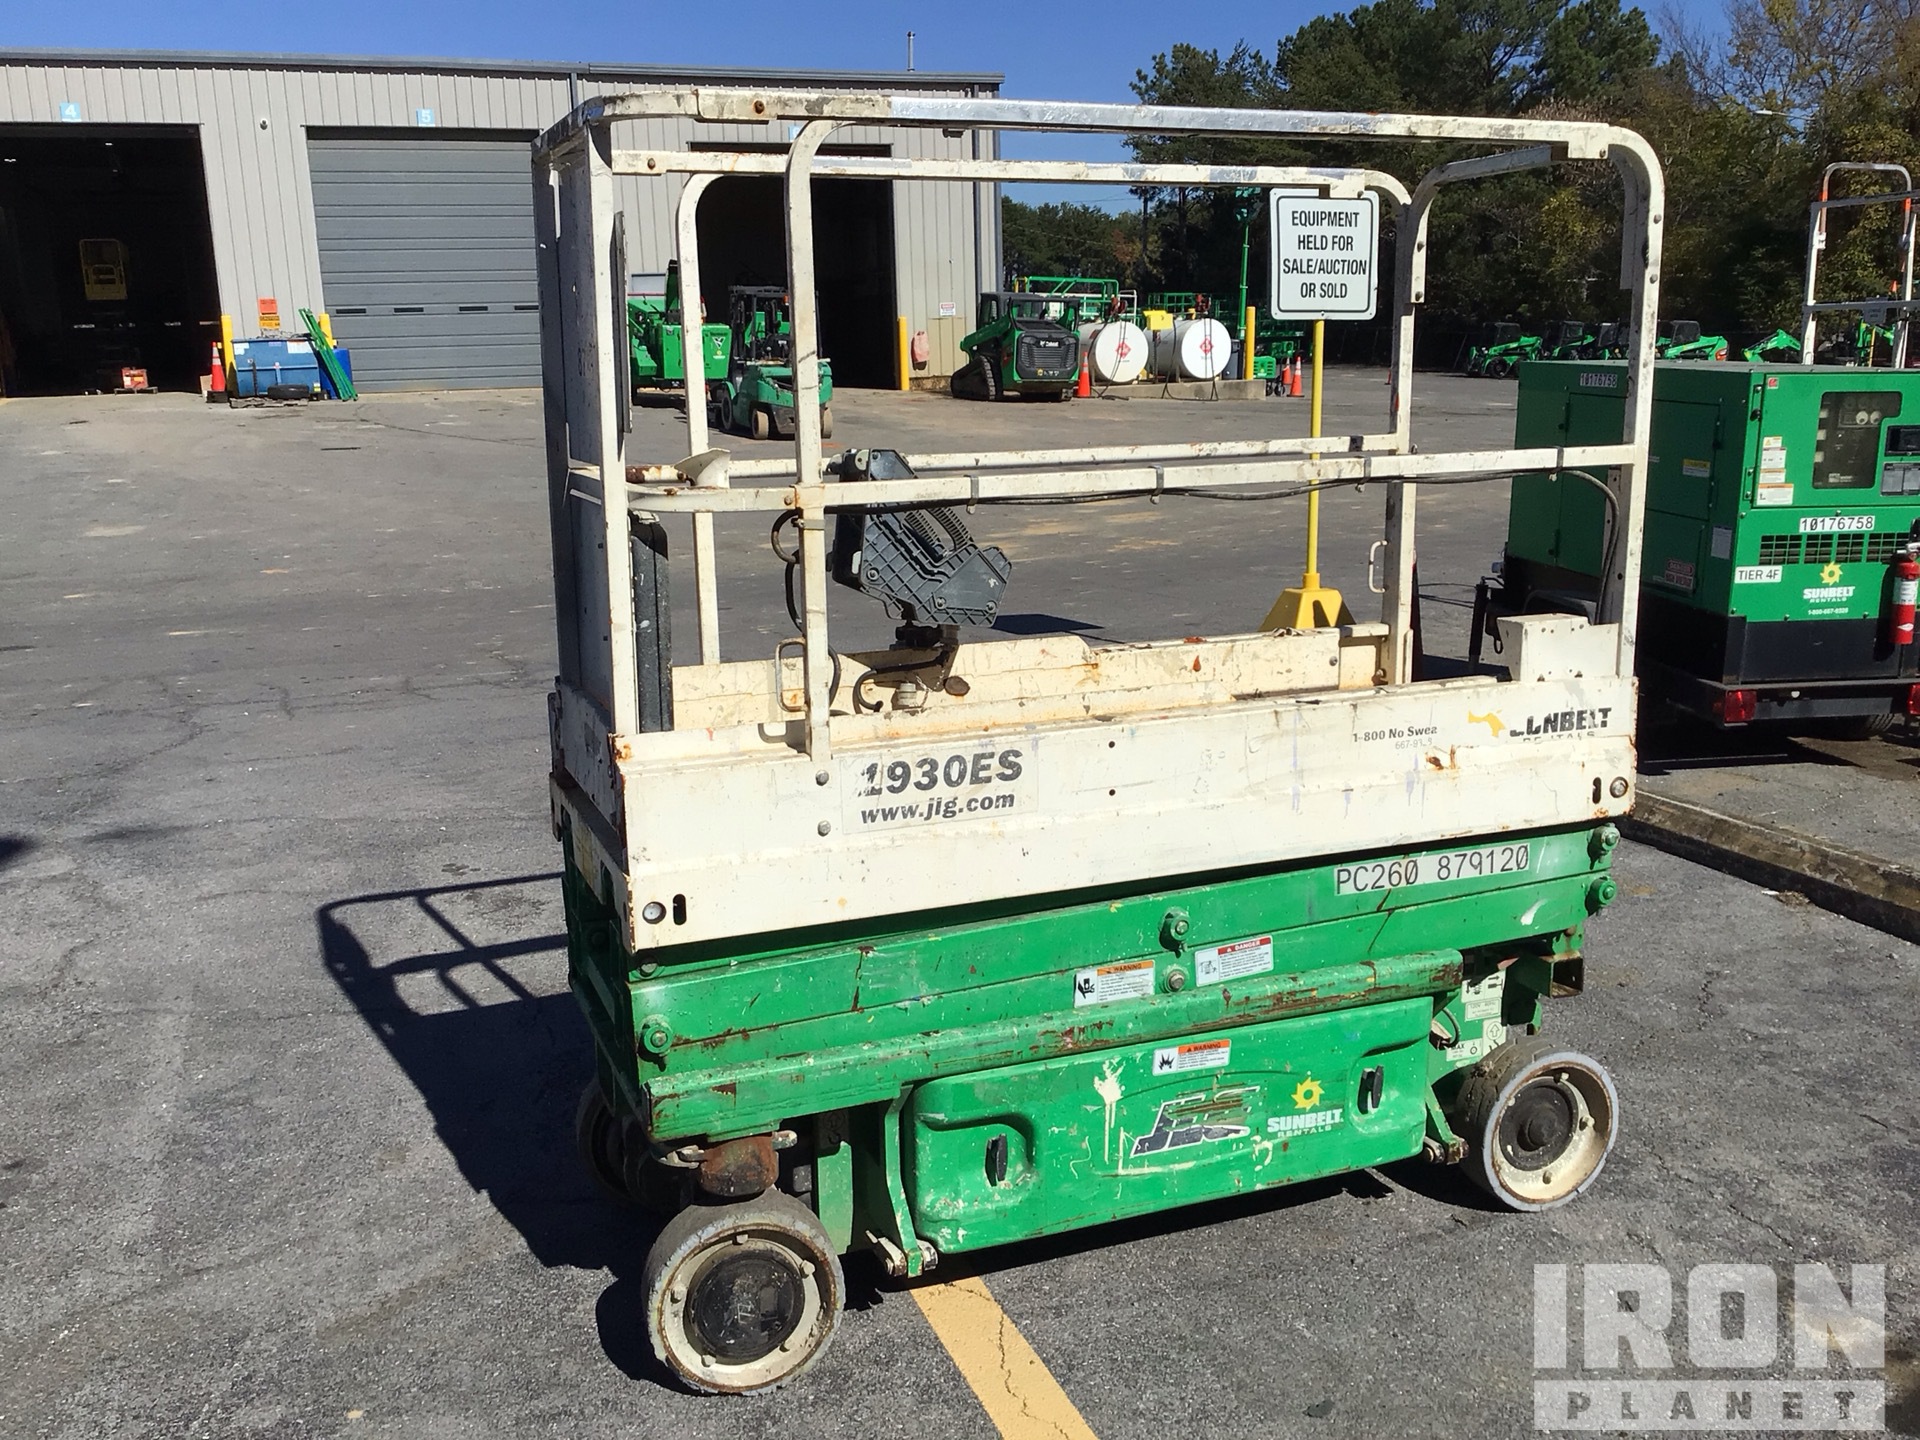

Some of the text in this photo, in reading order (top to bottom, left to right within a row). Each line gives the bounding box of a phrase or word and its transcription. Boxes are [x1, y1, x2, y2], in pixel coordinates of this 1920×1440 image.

[64, 103, 77, 118] 4
[421, 109, 431, 123] 5
[1291, 210, 1360, 228] EQUIPMENT
[1297, 234, 1354, 251] HELD FOR
[1282, 258, 1367, 275] SALE/AUCTION
[1300, 282, 1348, 298] OR SOLD
[1801, 516, 1874, 531] 10176758
[1738, 568, 1780, 581] TIER 4F
[1802, 585, 1856, 600] SUNBELT
[1509, 706, 1612, 738] UNBELT
[1352, 729, 1386, 743] 1-800
[1388, 726, 1405, 740] No
[857, 749, 1023, 797] 1930ES
[1336, 844, 1529, 895] PC260 879120
[1234, 940, 1261, 951] DANGER
[1113, 962, 1142, 973] WARNING
[1193, 1042, 1222, 1052] WARNING
[1266, 1108, 1344, 1134] SUNBELT
[1277, 1125, 1333, 1138] RENTALS
